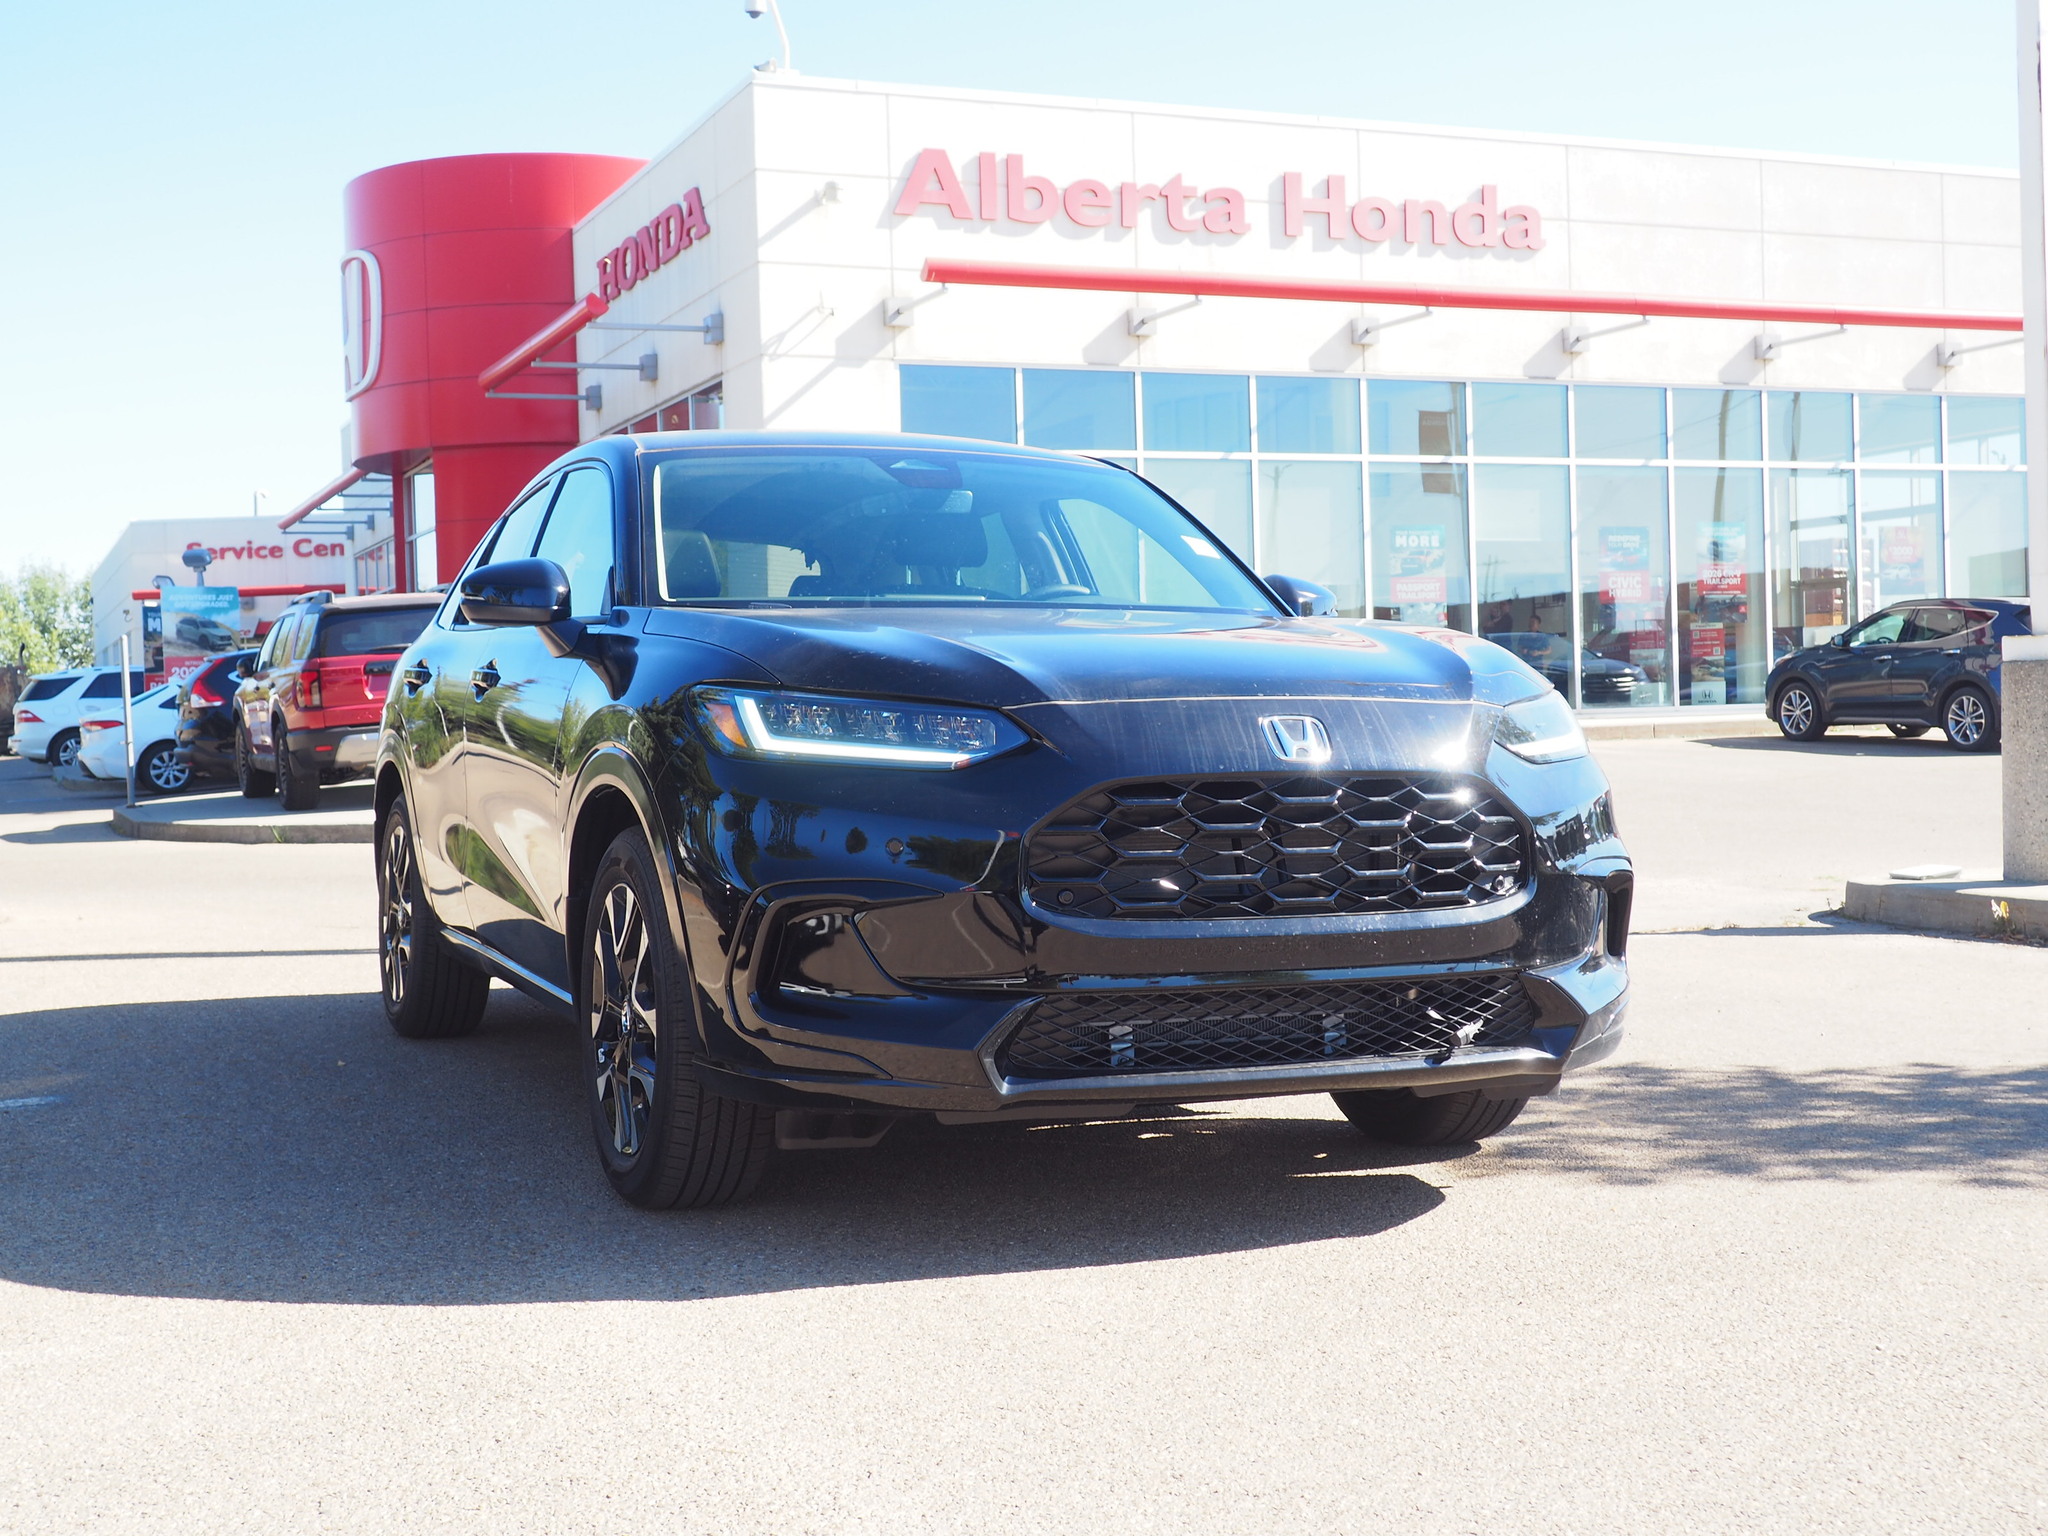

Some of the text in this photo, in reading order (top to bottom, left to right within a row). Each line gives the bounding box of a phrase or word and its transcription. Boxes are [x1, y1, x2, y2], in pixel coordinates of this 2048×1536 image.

[894, 148, 1546, 251] Alberta Honda
[596, 187, 711, 304] HONDA
[1395, 535, 1440, 547] MORE
[1608, 576, 1642, 588] CIVIC
[1703, 577, 1742, 585] TRAILSPORT
[1608, 588, 1642, 598] HYBRID
